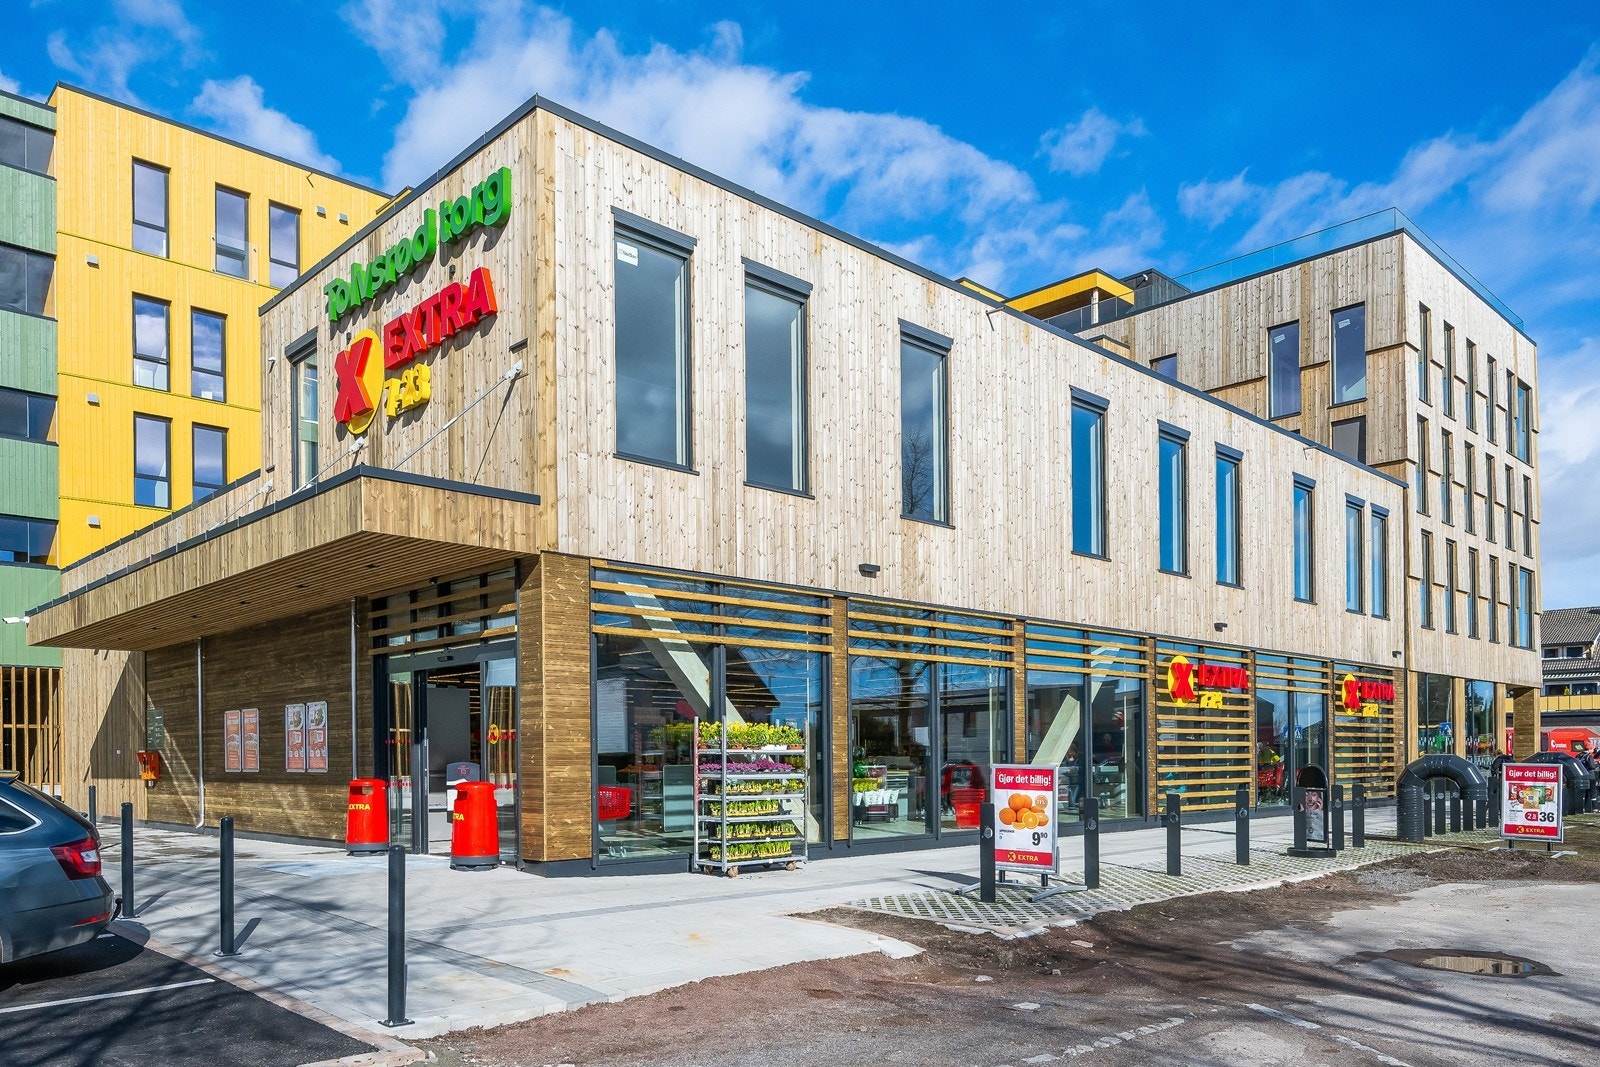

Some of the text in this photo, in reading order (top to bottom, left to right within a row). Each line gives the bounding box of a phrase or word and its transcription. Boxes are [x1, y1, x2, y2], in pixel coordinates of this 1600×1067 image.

[440, 167, 511, 243] torg
[384, 267, 498, 370] EXTRA
[384, 363, 430, 416] 7-23
[1198, 664, 1249, 689] EXTRA
[1361, 681, 1395, 701] EXTRA
[999, 773, 1051, 787] Gjør det billig!
[1508, 769, 1557, 780] Gjør det billig!
[1539, 811, 1555, 823] 36
[1017, 854, 1039, 862] EXTRA
